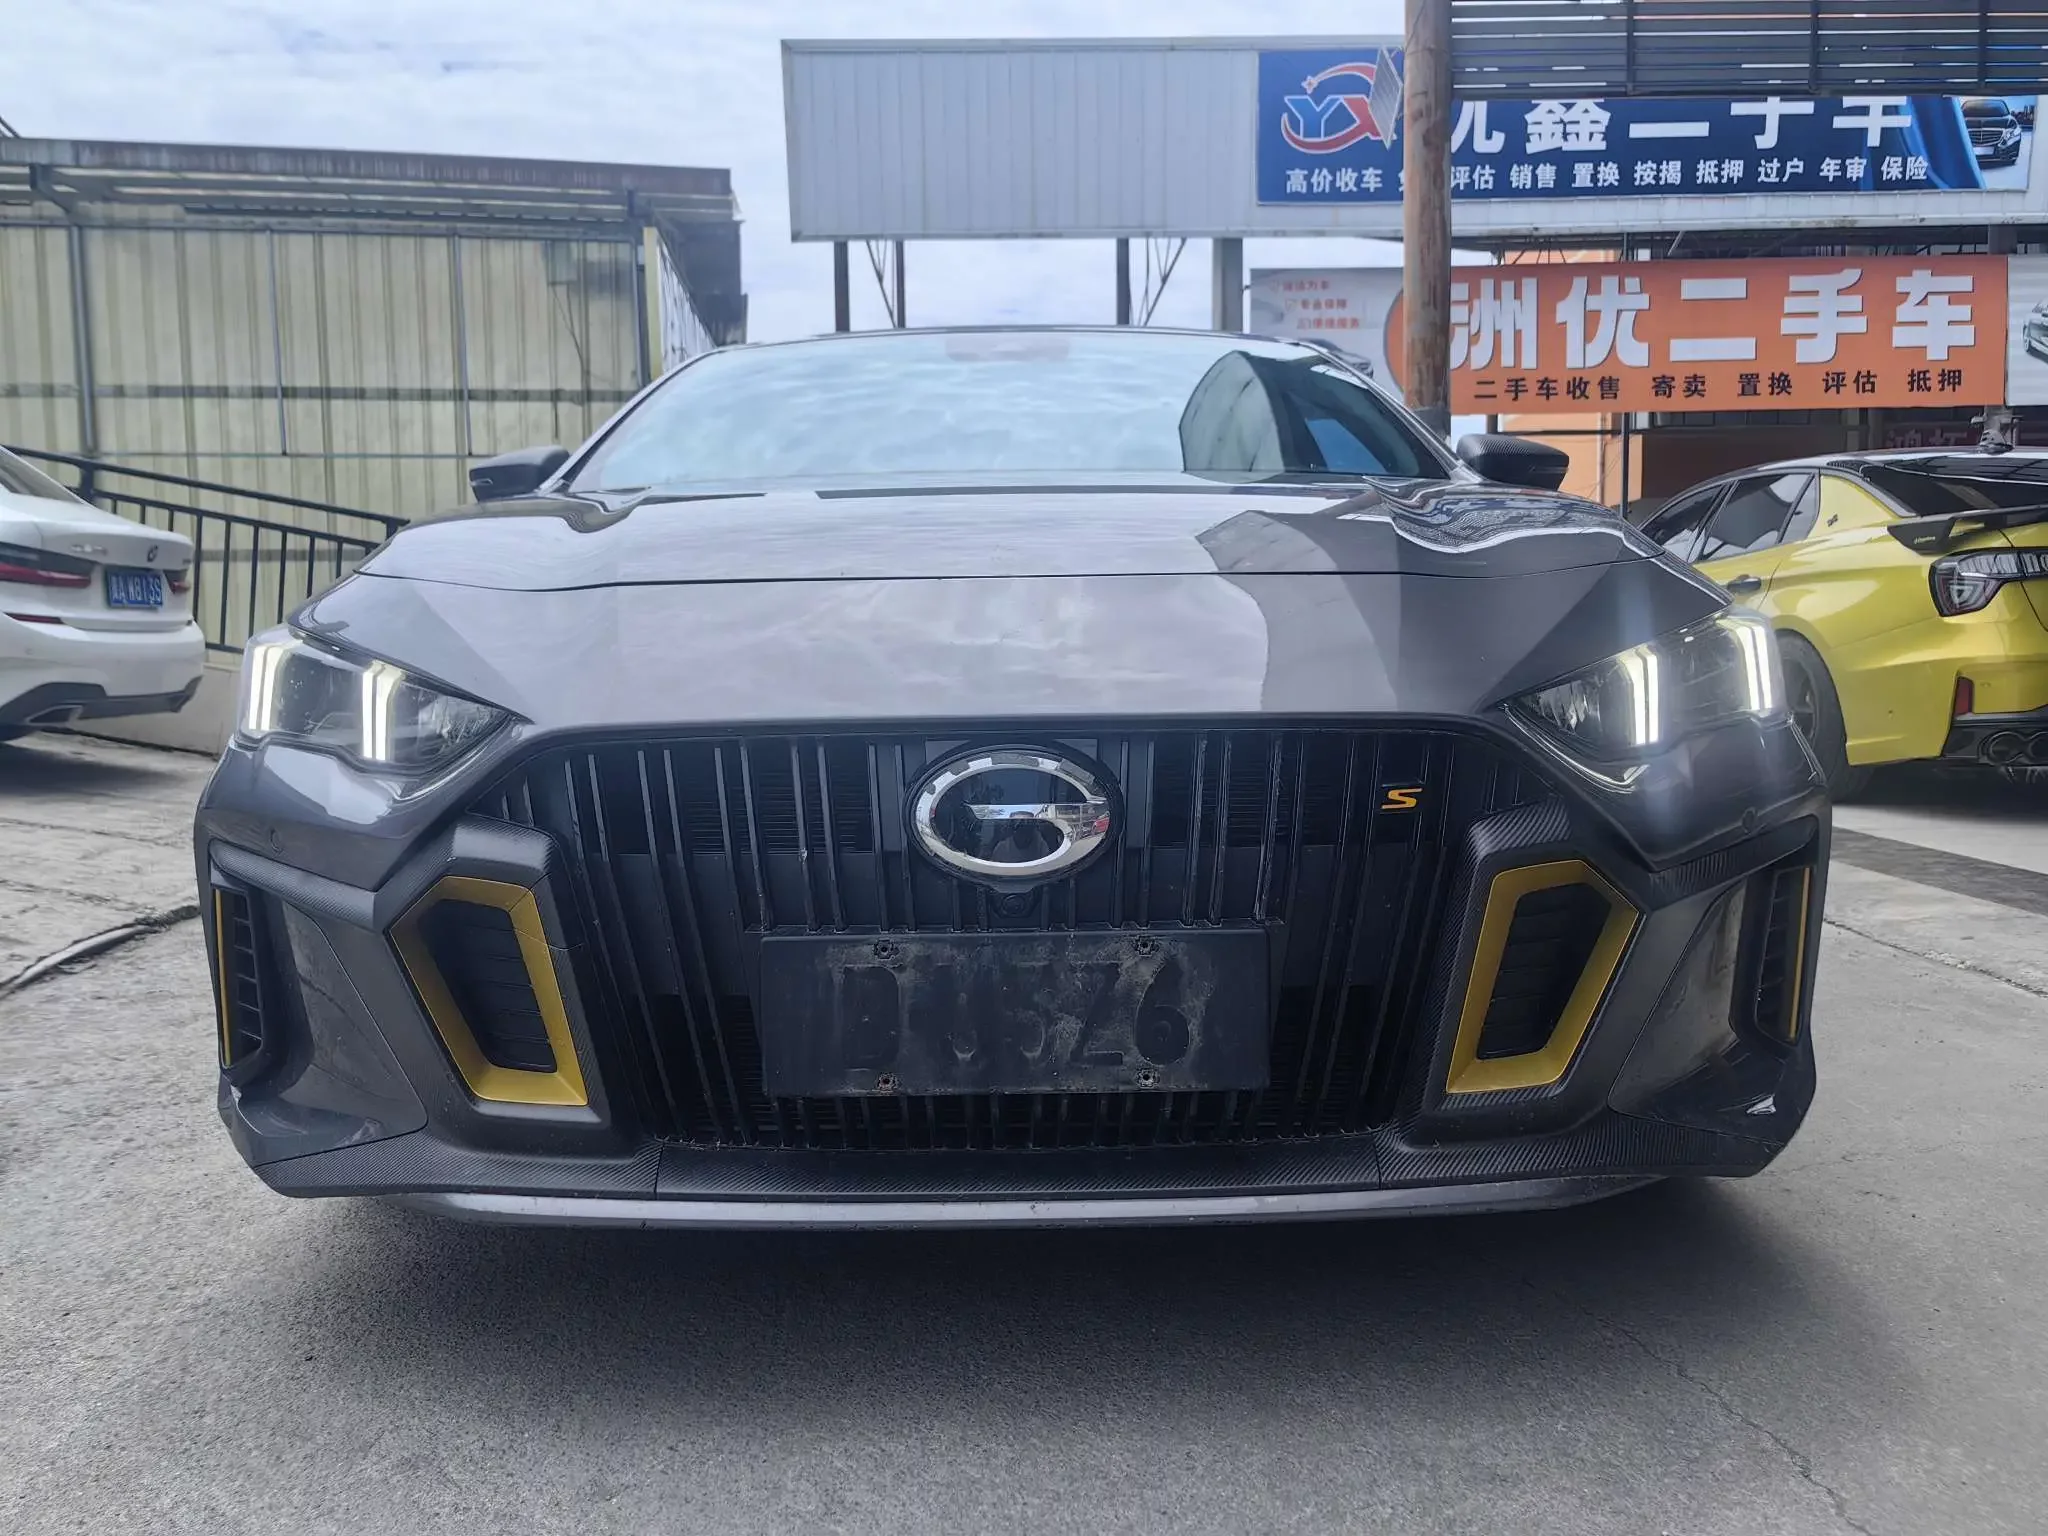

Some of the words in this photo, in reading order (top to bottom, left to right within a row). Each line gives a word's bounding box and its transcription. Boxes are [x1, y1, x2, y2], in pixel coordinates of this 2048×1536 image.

[1285, 167, 1384, 194] 高价收车
[1510, 163, 1557, 190] 销售
[1572, 161, 1620, 188] 置换
[1634, 160, 1682, 186] 按揭
[1696, 159, 1744, 185] 抵押
[1757, 157, 1804, 183] 过户
[1819, 156, 1867, 182] 年审
[1880, 155, 1929, 181] 保险
[1474, 375, 1620, 401] 二手车收售
[1651, 374, 1706, 399] 寄卖
[1737, 371, 1792, 397] 置换
[1822, 370, 1878, 395] 评估
[1907, 368, 1962, 393] 抵押
[1382, 788, 1423, 809] S
